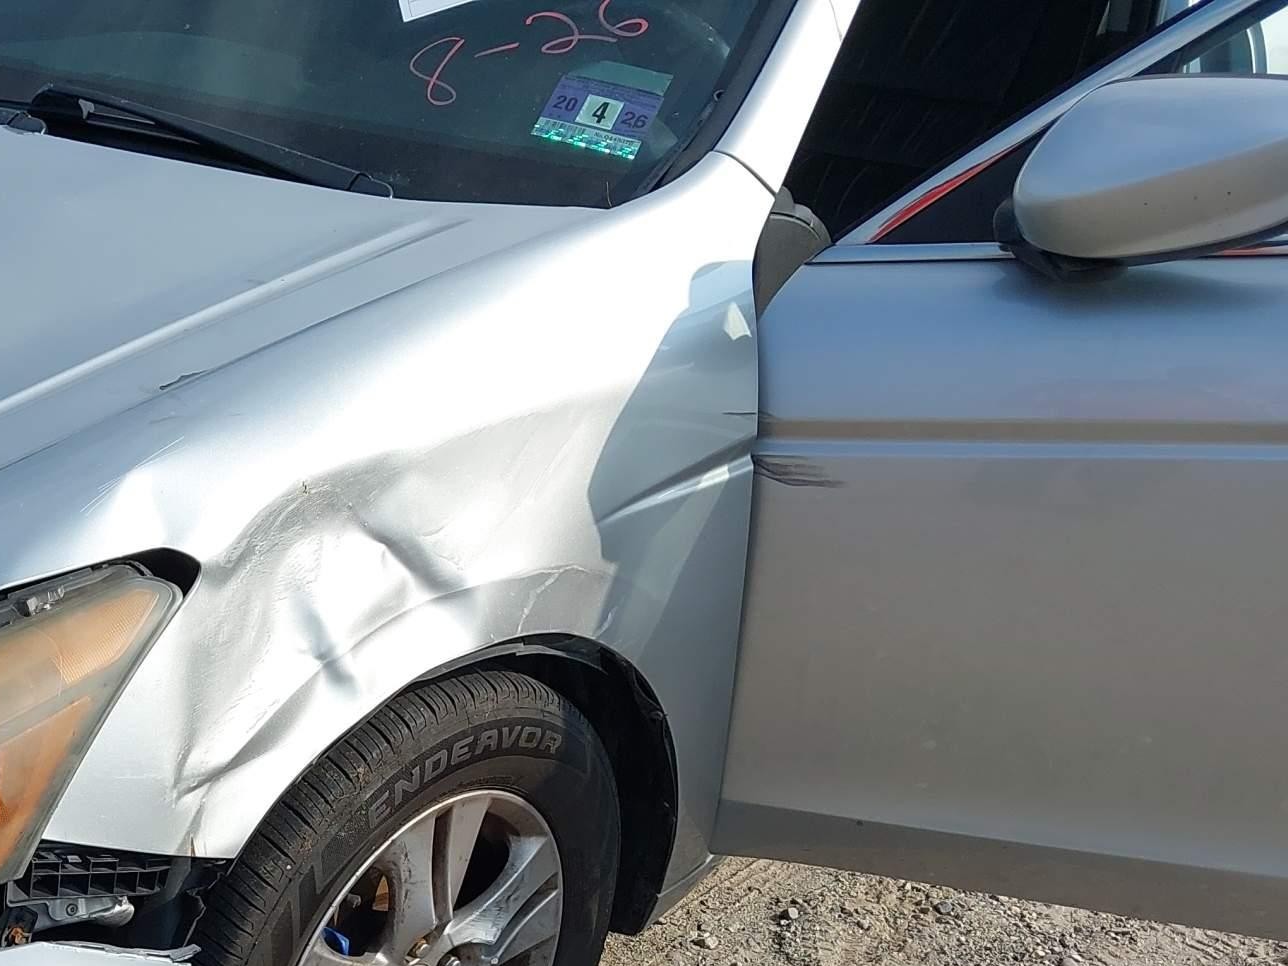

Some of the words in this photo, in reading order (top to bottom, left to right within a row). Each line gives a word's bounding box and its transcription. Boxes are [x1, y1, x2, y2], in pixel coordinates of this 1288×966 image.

[552, 95, 578, 112] 20
[591, 101, 611, 124] 4
[621, 111, 648, 129] 26
[368, 725, 563, 829] ENDEAVOR
